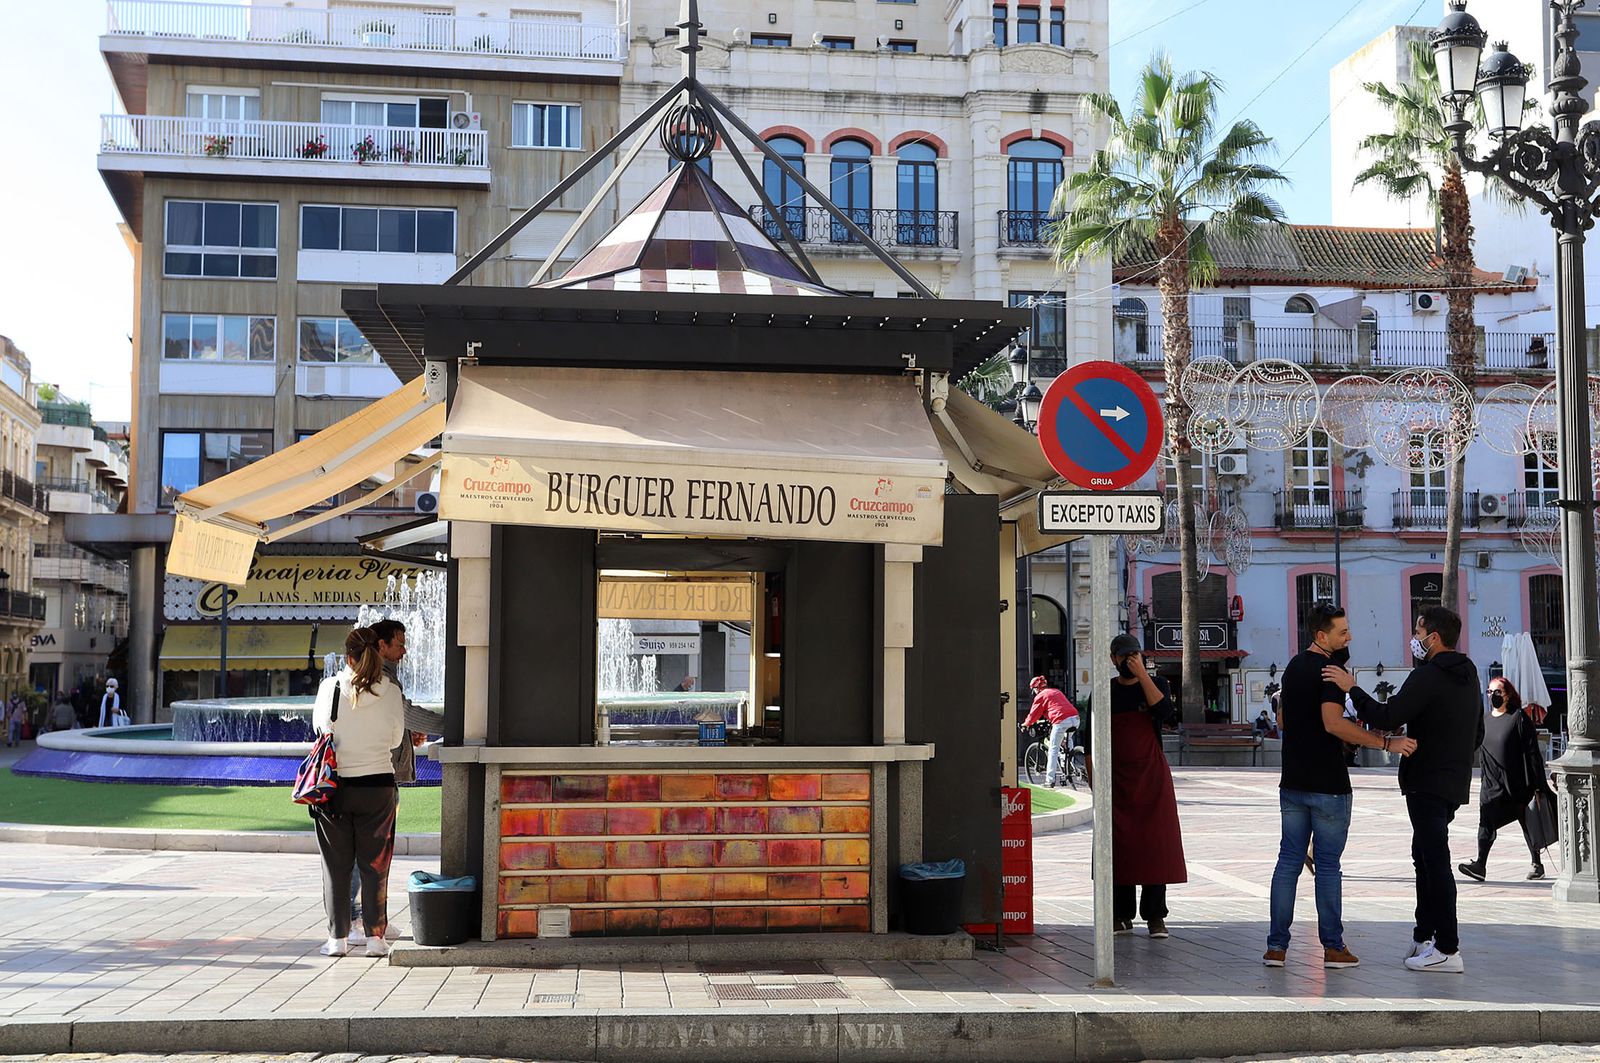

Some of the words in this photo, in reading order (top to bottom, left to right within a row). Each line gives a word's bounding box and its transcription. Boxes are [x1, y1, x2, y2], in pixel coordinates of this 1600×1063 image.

[463, 477, 531, 495] Cruzcampo
[1090, 477, 1114, 486] GRUA
[545, 471, 677, 519] BURGUER
[684, 479, 836, 527] FERNANDO
[849, 497, 914, 515] Cruzcampo
[847, 512, 878, 520] MAESTROS
[879, 514, 916, 522] CERVECEROS
[1051, 503, 1114, 524] EXCEPTO
[1117, 504, 1156, 524] TAXIS
[355, 558, 436, 581] Plaz
[259, 591, 301, 603] LANAS
[312, 591, 361, 603] MEDIAS
[1483, 615, 1507, 623] PLAZA
[639, 638, 666, 652] Suizo
